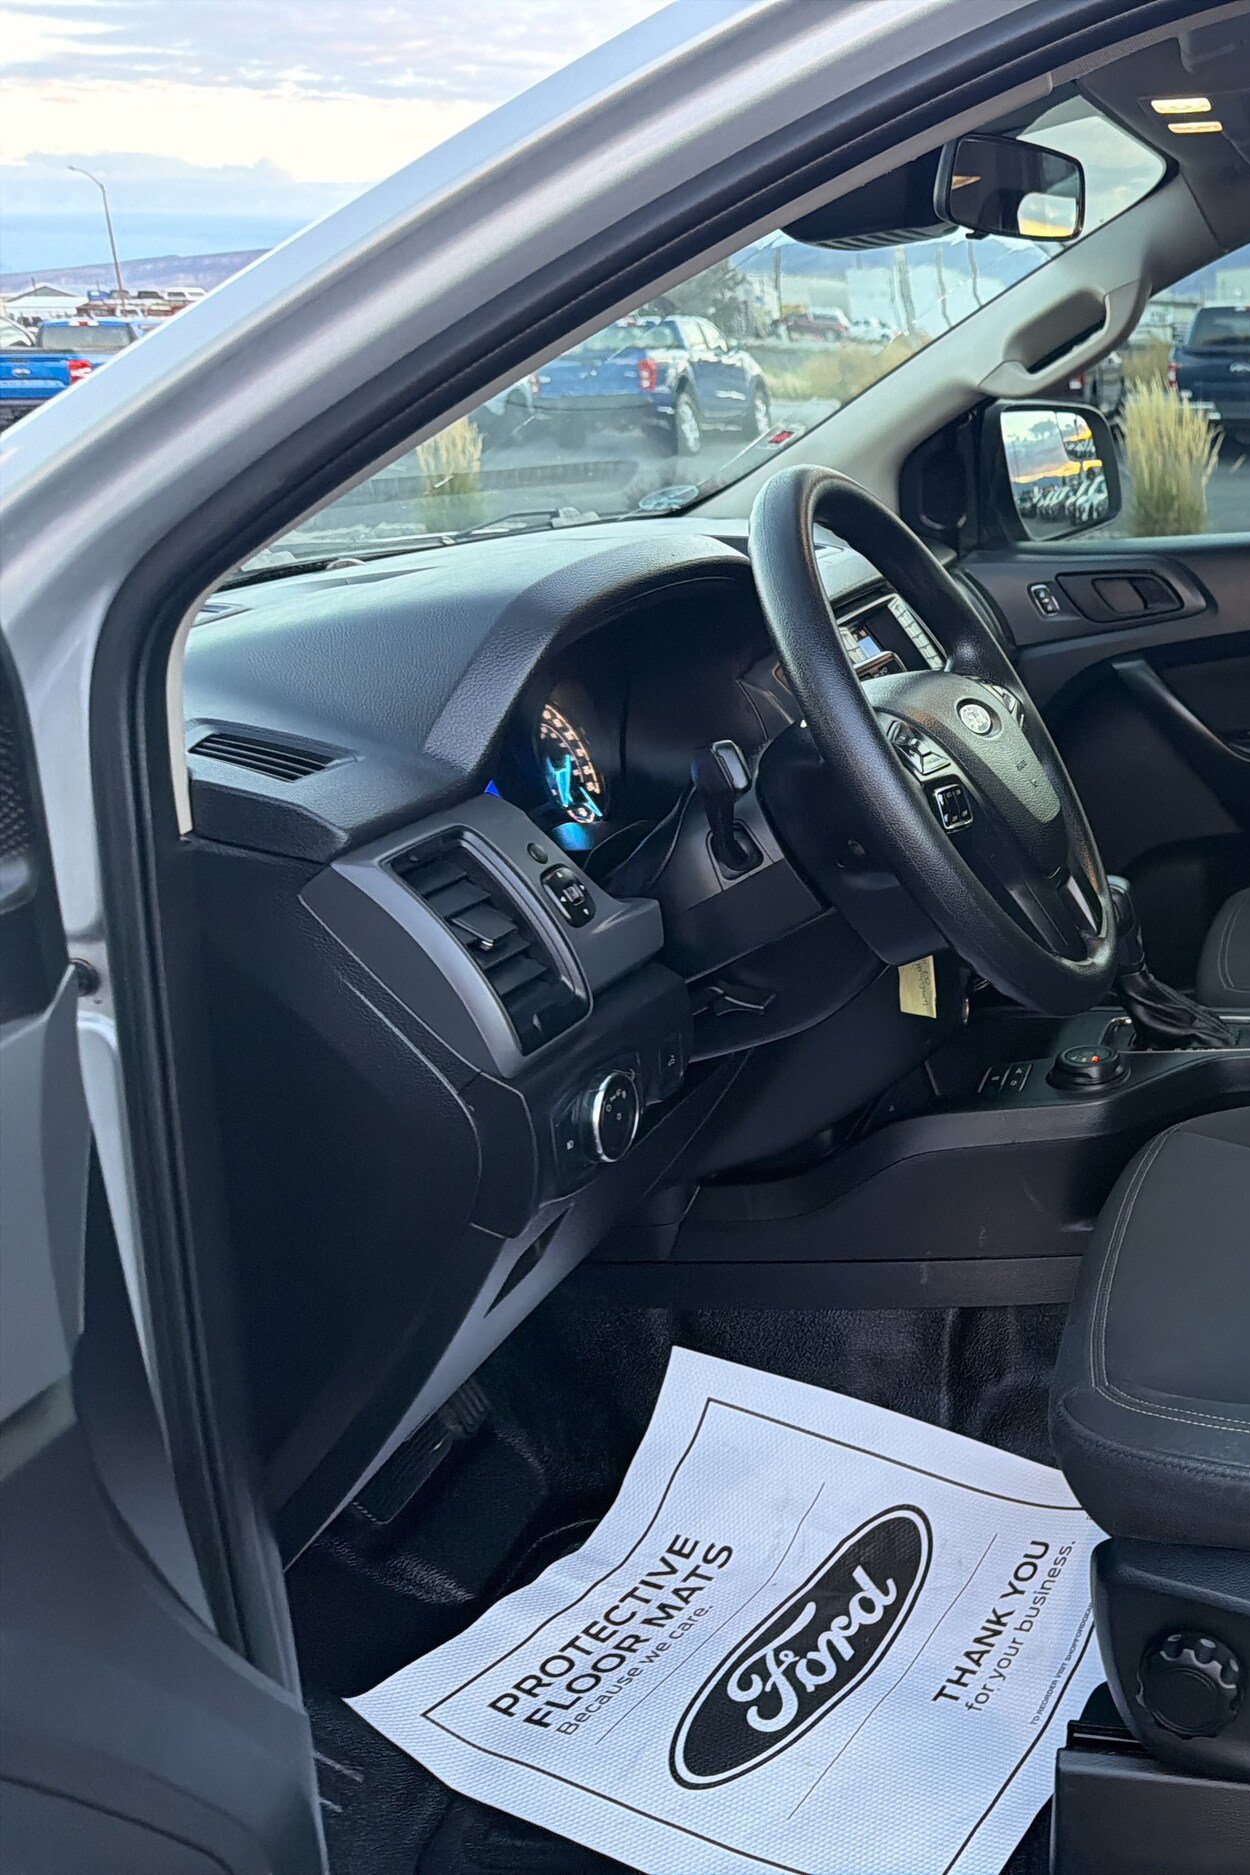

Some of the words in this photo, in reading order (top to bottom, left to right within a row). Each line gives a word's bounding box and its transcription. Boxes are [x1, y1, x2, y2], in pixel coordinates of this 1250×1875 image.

[487, 1534, 700, 1717] PROTECTIVE
[523, 1634, 652, 1728] FLOOR
[640, 1542, 733, 1628] MATS
[555, 1667, 643, 1735] Because
[639, 1642, 671, 1664] we
[669, 1605, 713, 1640] care.
[727, 1565, 897, 1732] Ford
[931, 1608, 1016, 1702] THANK
[999, 1540, 1050, 1600] YOU
[965, 1683, 995, 1712] for
[989, 1637, 1024, 1681] your
[1014, 1541, 1076, 1633] business.
[1037, 1680, 1058, 1716] REORDER
[1055, 1662, 1068, 1679] VISIT
